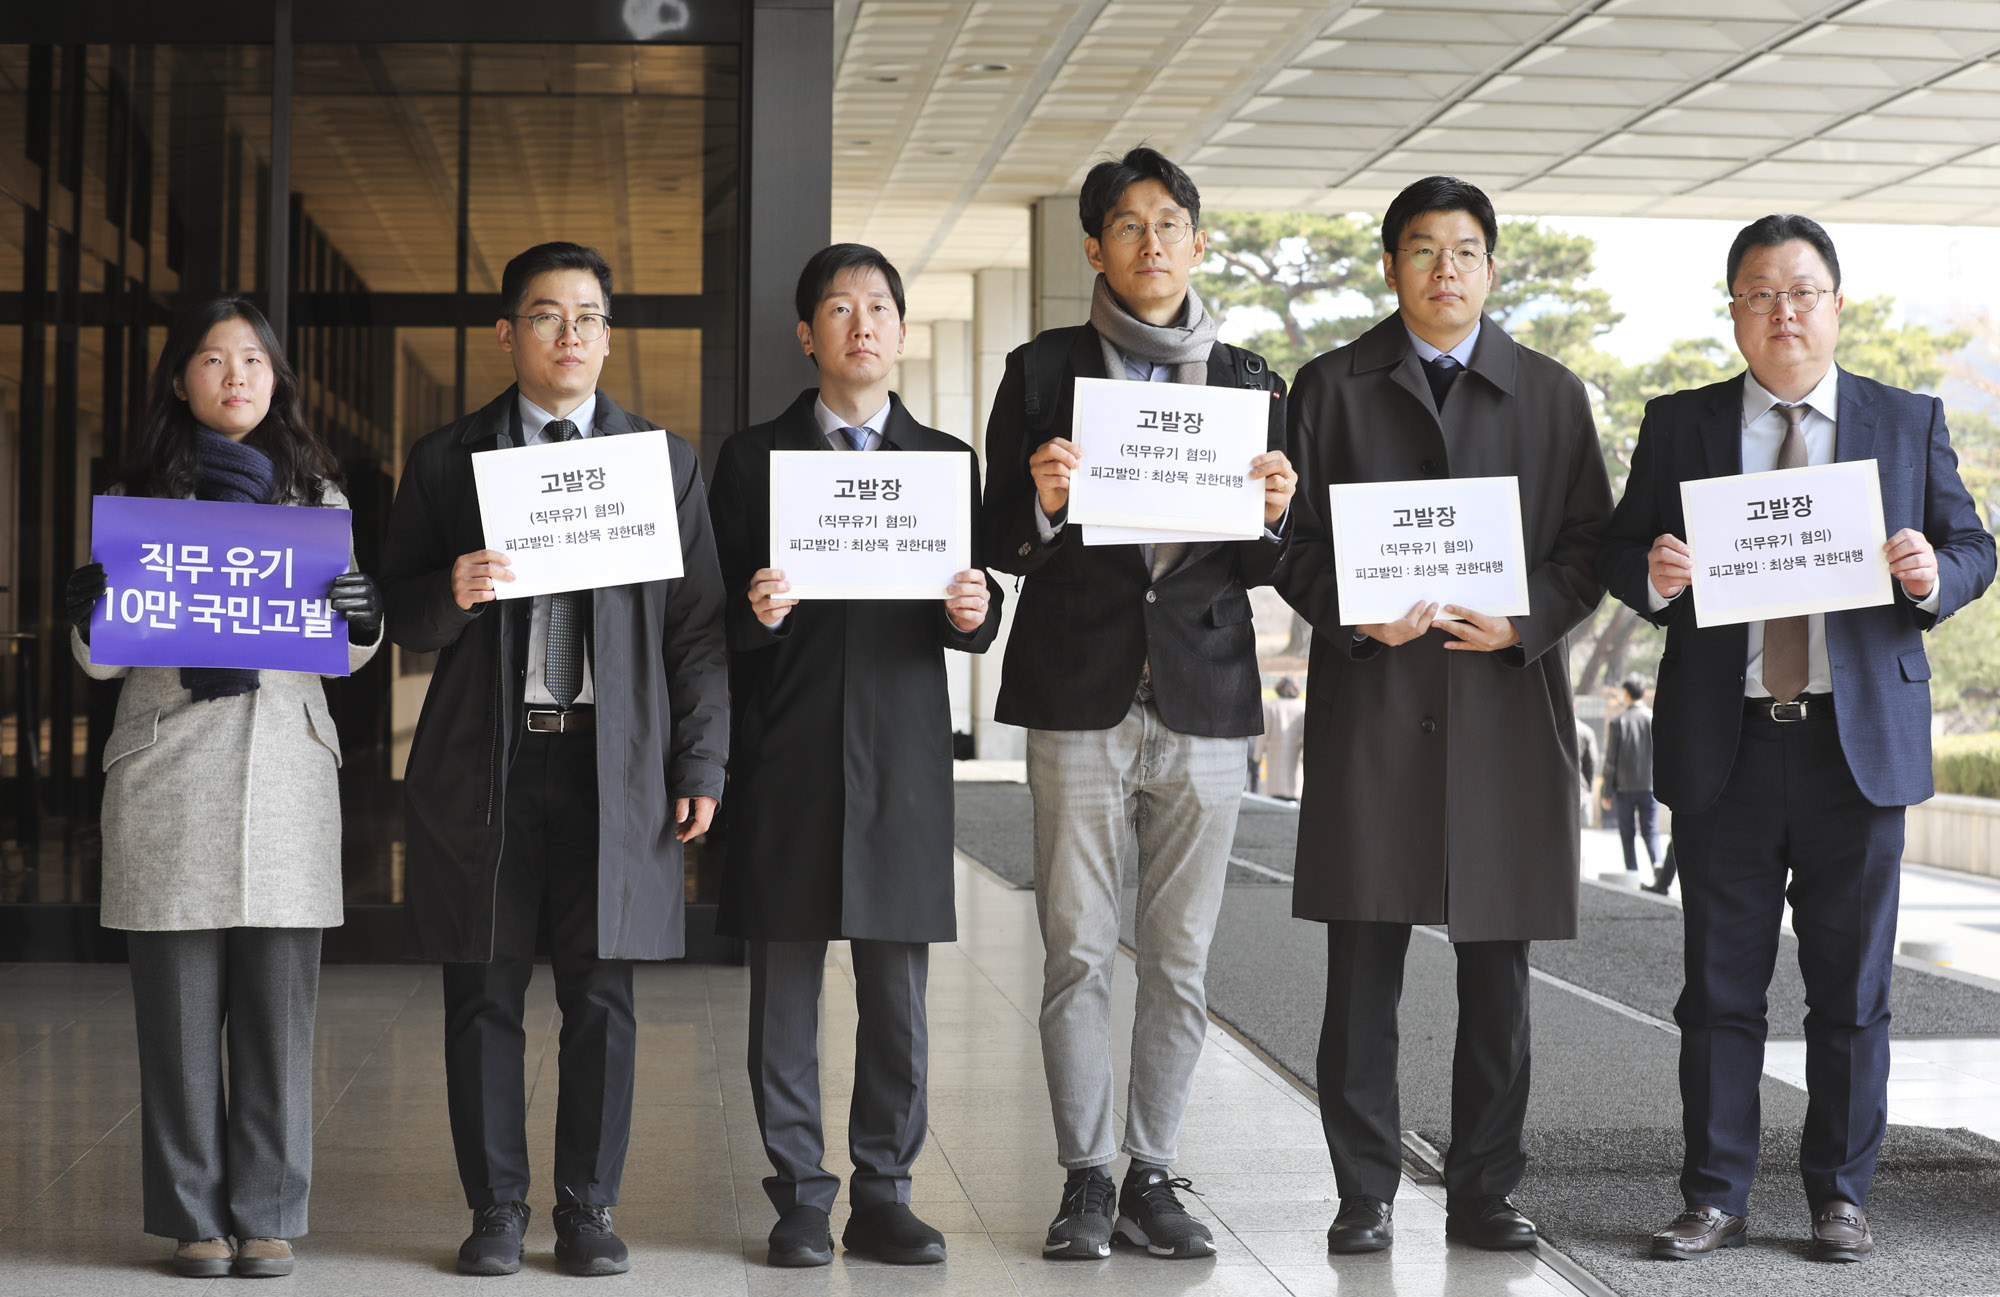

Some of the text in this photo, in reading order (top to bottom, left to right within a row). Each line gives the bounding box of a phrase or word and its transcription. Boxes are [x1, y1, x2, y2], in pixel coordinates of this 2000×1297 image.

[1136, 410, 1204, 435] 고발장
[1120, 443, 1217, 463] (직무유기 혐의)
[540, 467, 606, 494] 고발장
[833, 478, 902, 501] 고발장
[1151, 469, 1188, 484] 최상목
[1196, 473, 1243, 488] 권한대행
[530, 502, 625, 525] (직무유기 혐의)
[1392, 505, 1457, 529] 고발장
[1746, 494, 1813, 521] 고발장
[818, 514, 917, 529] (직무유기 혐의)
[565, 529, 601, 545] 최상목
[609, 522, 656, 540] 권한대행
[1734, 528, 1832, 552] (직무유기 혐의)
[851, 538, 889, 552] 최상목
[896, 539, 946, 553] 권한대행
[1380, 539, 1474, 556] (직무유기 혐의)
[140, 544, 292, 588] 직무 유기
[1413, 563, 1449, 577] 최상목
[1455, 560, 1504, 575] 권한대행
[1769, 555, 1808, 571] 최상목
[1813, 549, 1864, 567] 권한대행
[105, 587, 336, 637] 10만 국민고발
